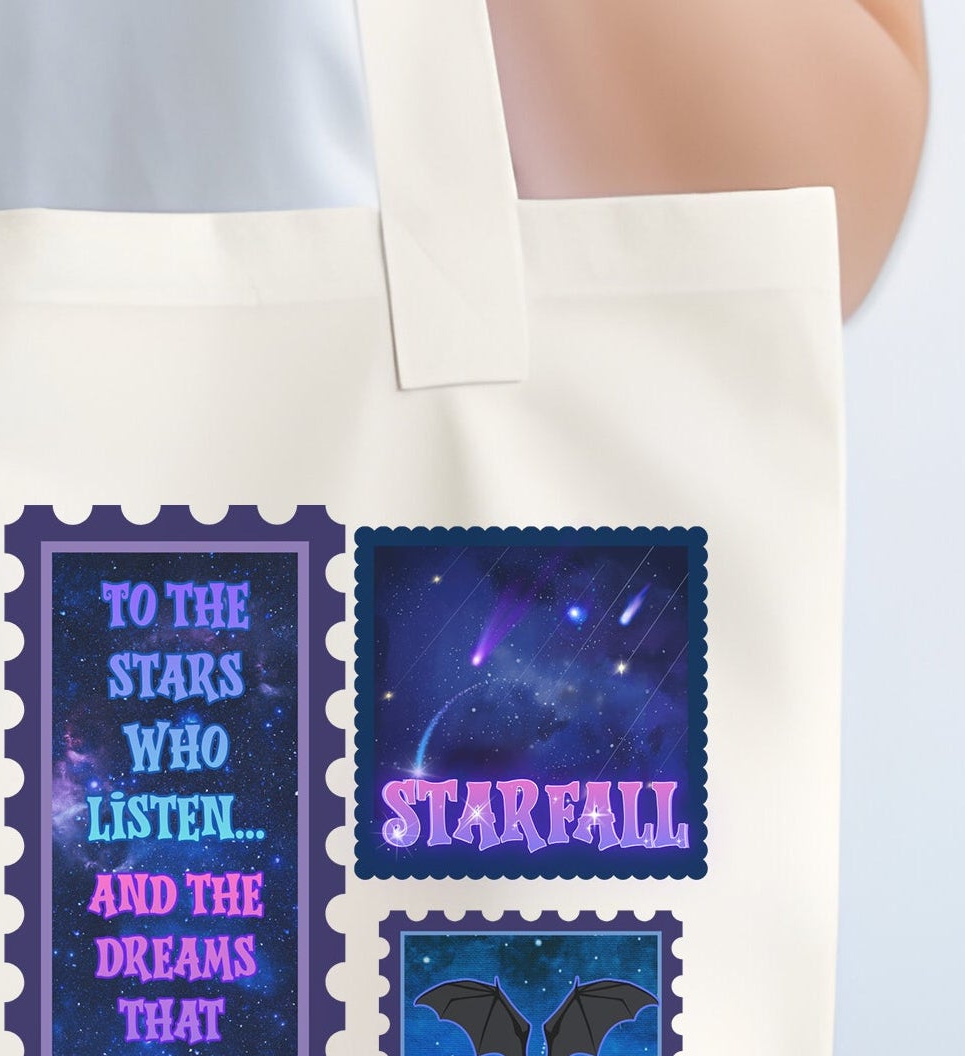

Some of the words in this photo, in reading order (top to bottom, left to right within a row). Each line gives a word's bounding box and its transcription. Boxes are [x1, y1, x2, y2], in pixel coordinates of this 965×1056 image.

[101, 580, 157, 629] TO
[165, 580, 250, 630] THE
[108, 652, 245, 704] STARS
[122, 720, 230, 773] WHO
[382, 777, 689, 853] STARFALL
[87, 872, 177, 918] AND
[186, 872, 264, 917] THE
[95, 934, 257, 983] DREAMS
[118, 998, 224, 1044] THAT
